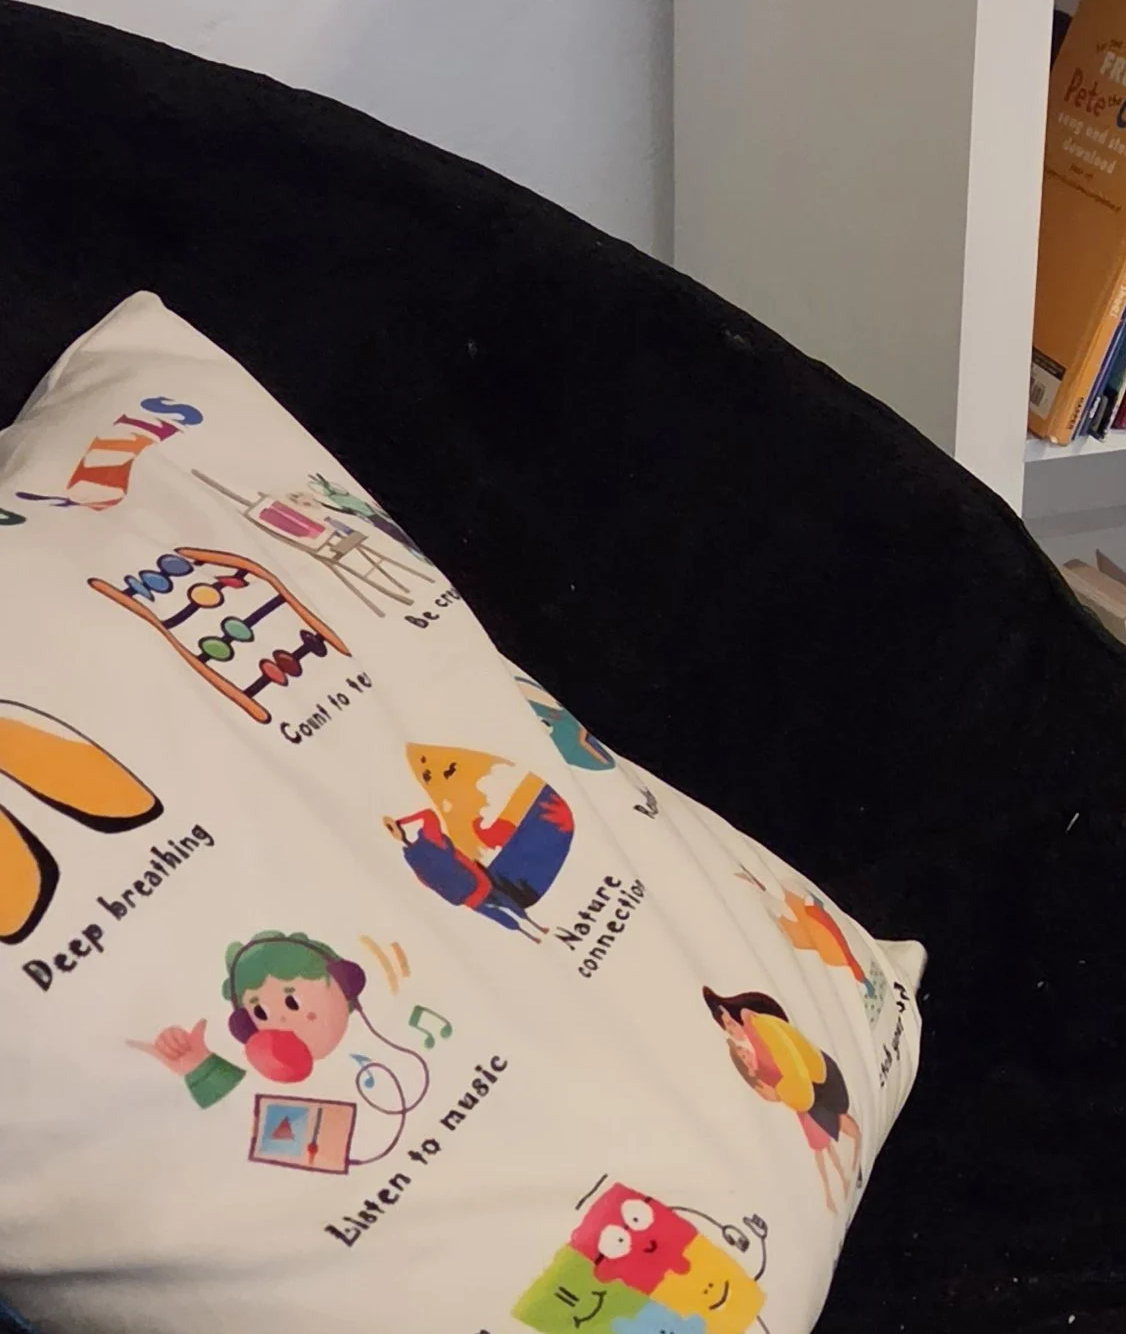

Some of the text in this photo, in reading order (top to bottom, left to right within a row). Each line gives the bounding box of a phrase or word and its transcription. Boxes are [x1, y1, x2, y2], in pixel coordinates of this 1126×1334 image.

[1063, 67, 1106, 118] Pete
[405, 610, 440, 630] Be
[280, 703, 334, 744] Count
[327, 686, 351, 709] to
[22, 823, 215, 993] Deep breathing
[553, 872, 622, 951] Nature
[324, 1055, 508, 1247] Listen to music
